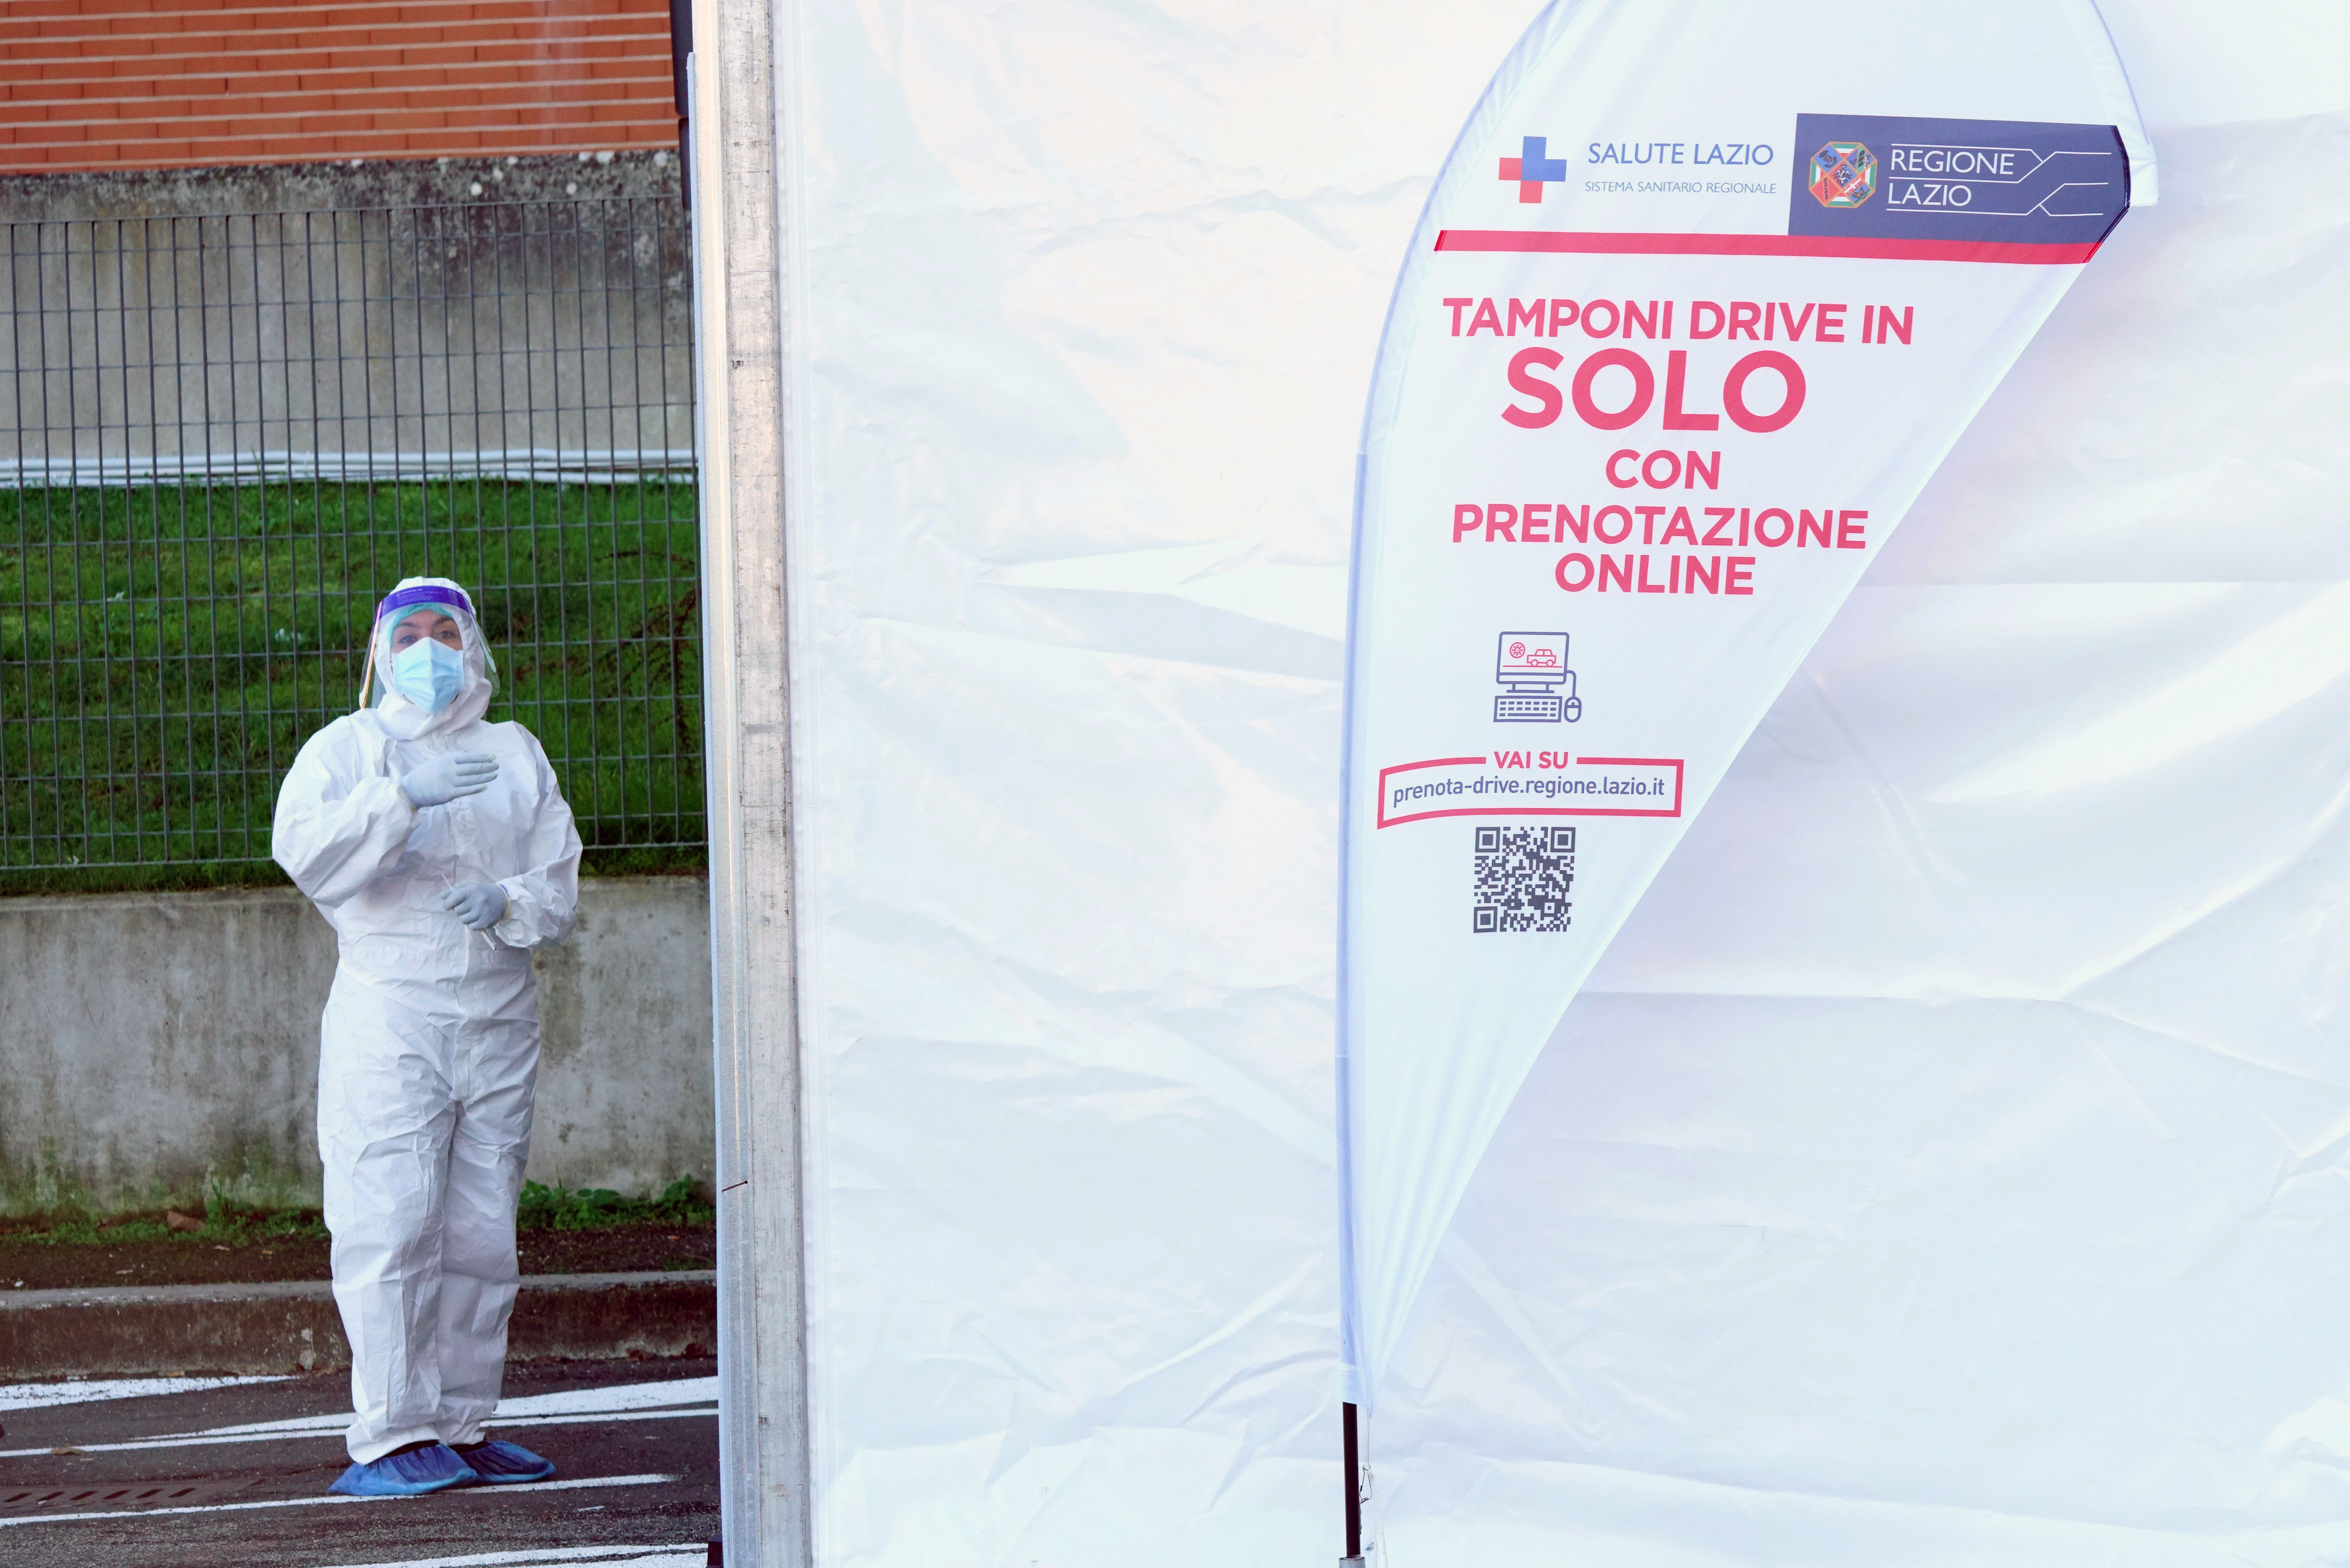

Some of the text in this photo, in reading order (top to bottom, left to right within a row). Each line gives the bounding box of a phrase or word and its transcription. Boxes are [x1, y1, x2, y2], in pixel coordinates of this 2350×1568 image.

[1589, 143, 1773, 165] SALUTE LAZIO
[1891, 149, 2014, 175] REGIONE
[1586, 181, 1776, 194] SISTEMA SANITARIO REGIONALE
[1888, 183, 1972, 206] LAZIO
[1443, 298, 1914, 344] TAMPONI DRIVE IN
[1501, 347, 1806, 433] SOLO
[1606, 449, 1721, 490] CON
[1453, 504, 1868, 549] PRENOTAZIONE
[1555, 553, 1756, 595] ONLINE
[1494, 751, 1568, 769] VAI SU
[1393, 776, 1665, 808] prenota-drive.regione.lazio.it
